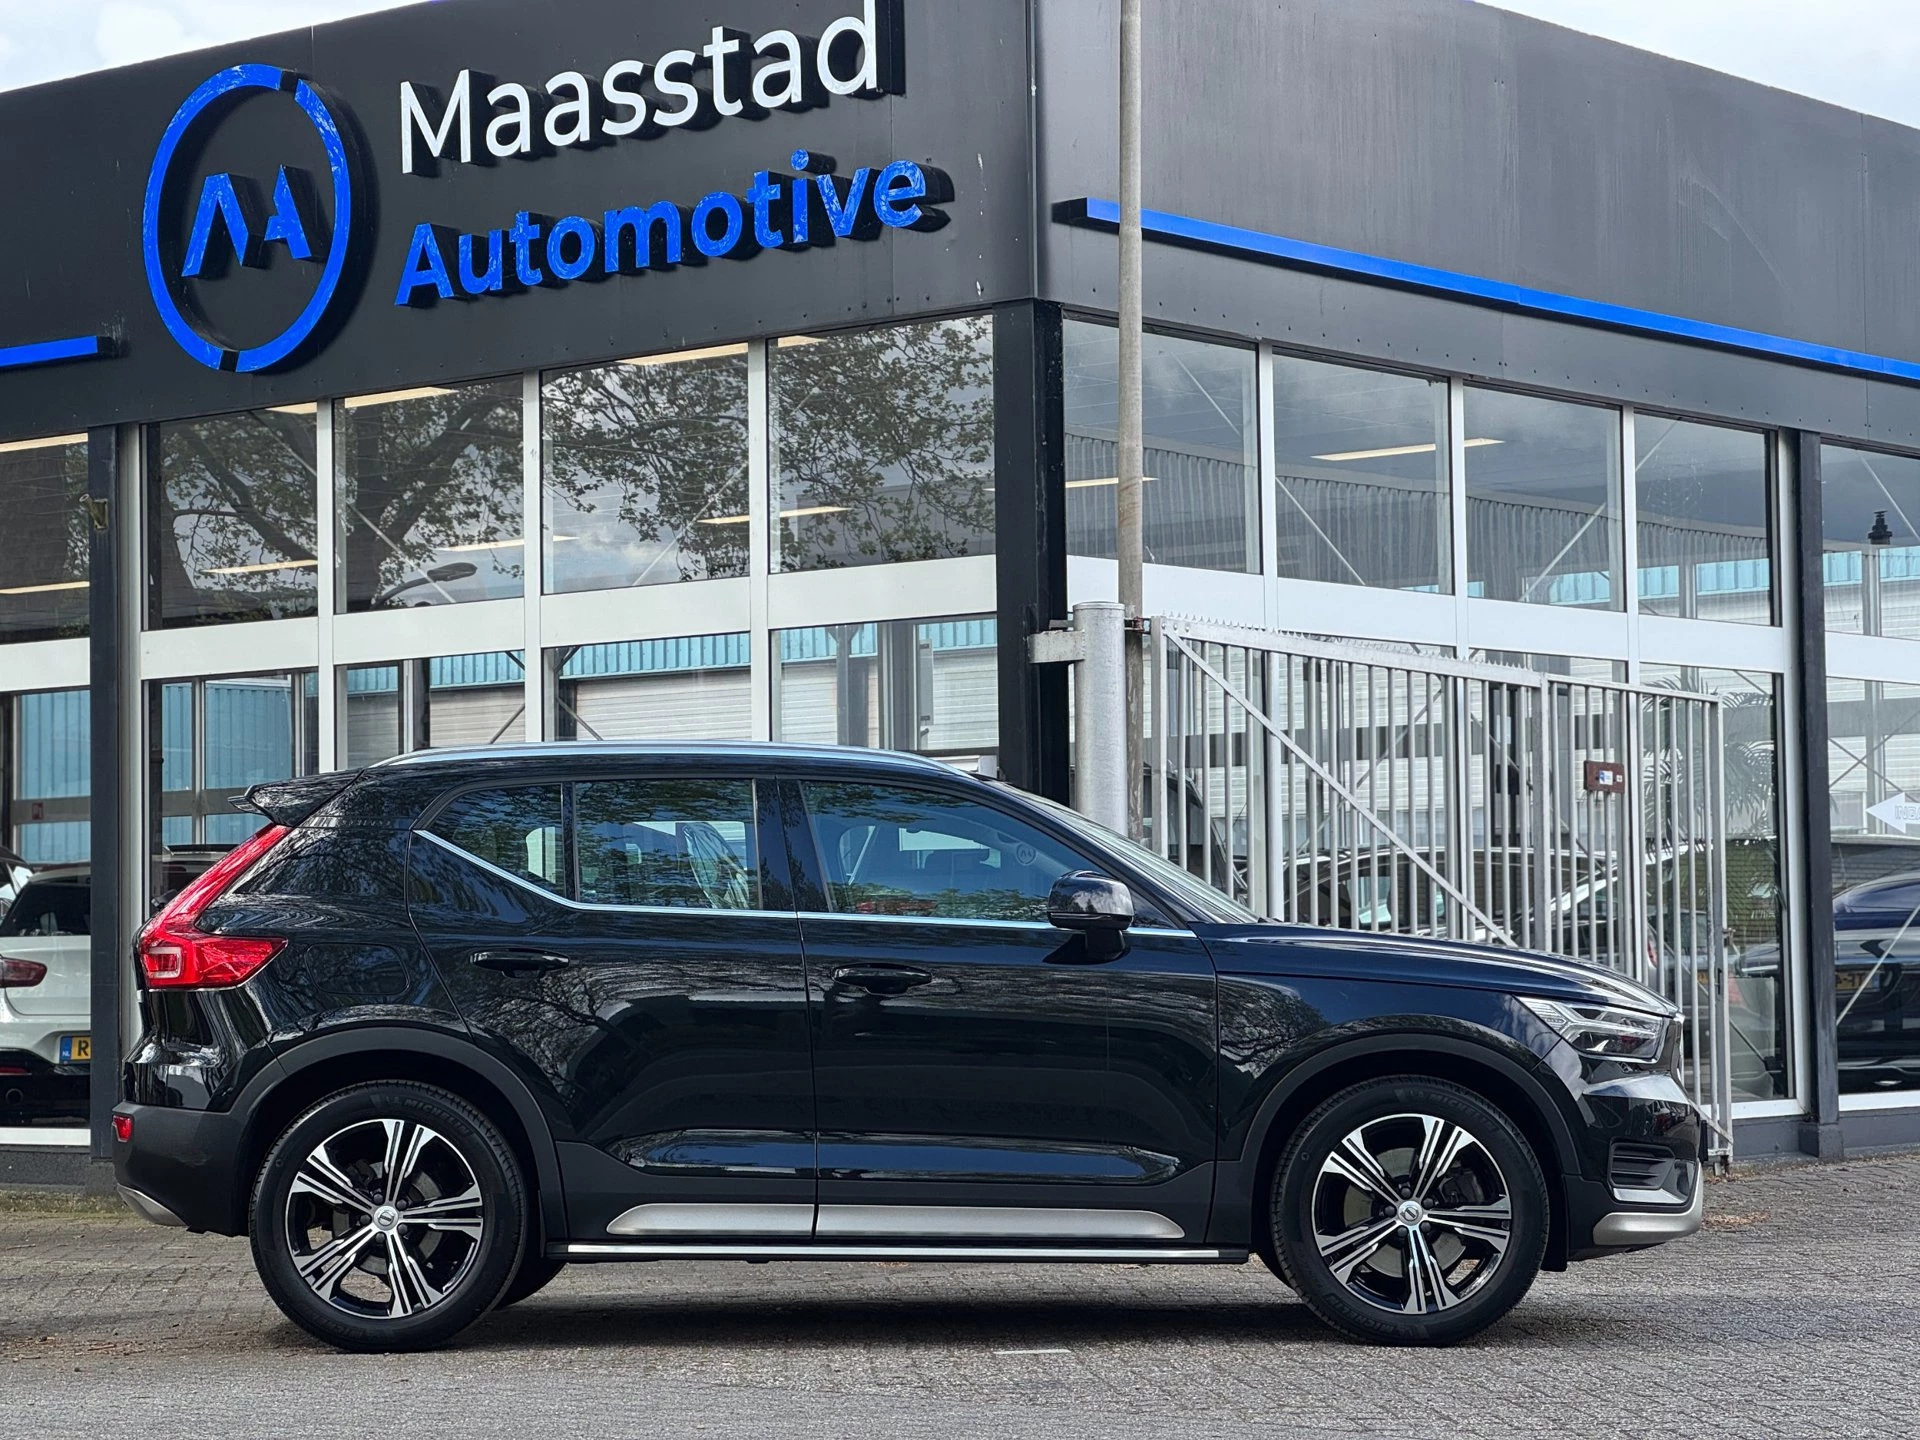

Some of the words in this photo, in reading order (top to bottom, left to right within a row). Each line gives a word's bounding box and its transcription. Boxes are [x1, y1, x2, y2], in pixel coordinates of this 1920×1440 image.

[401, 0, 877, 173] Maasstad
[394, 149, 926, 306] Automotive
[403, 1098, 471, 1135] MICHELIN
